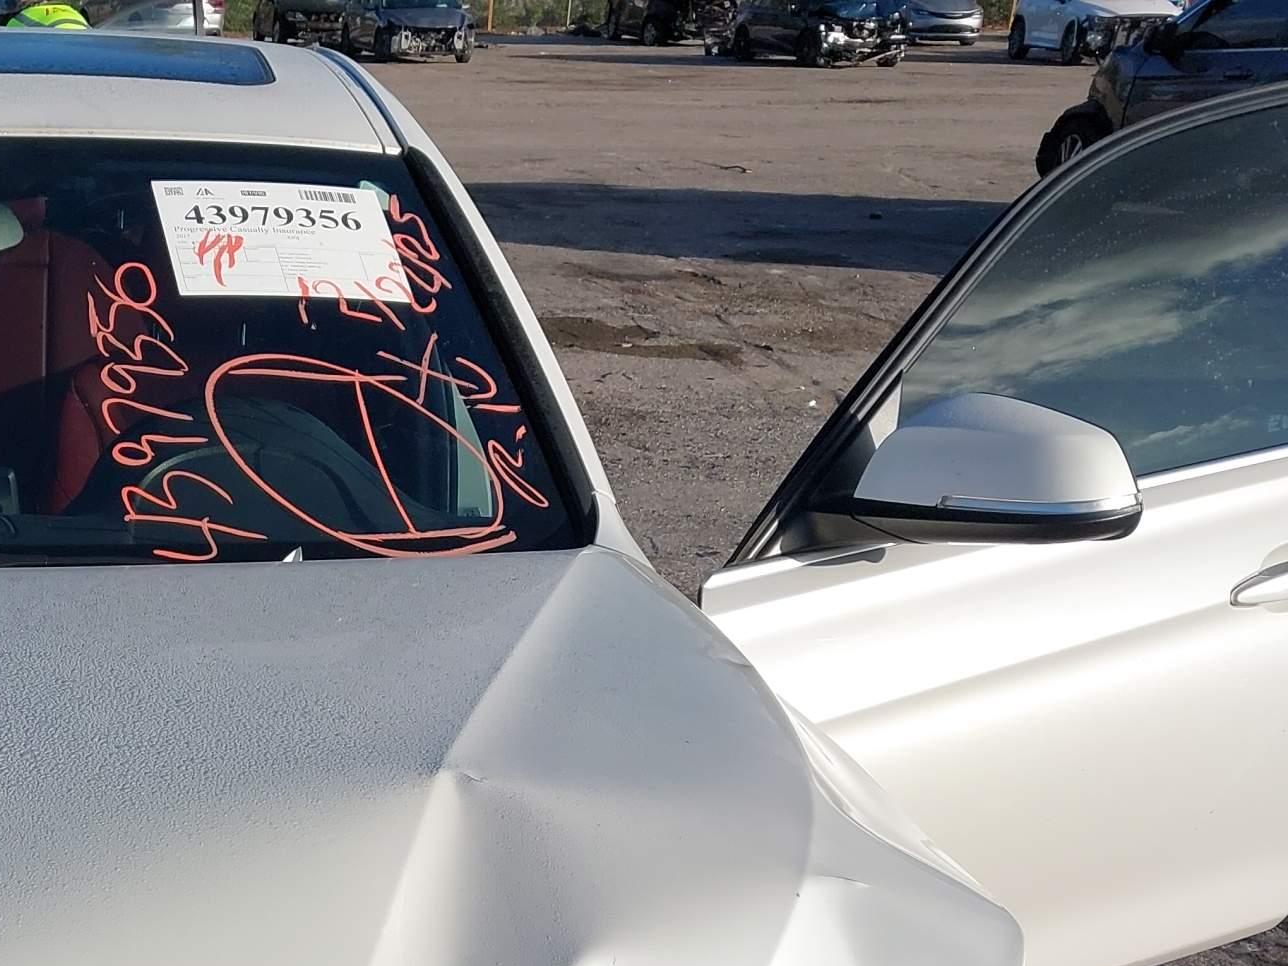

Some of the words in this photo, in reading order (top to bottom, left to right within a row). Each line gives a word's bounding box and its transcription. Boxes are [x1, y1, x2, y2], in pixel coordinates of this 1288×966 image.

[173, 225, 228, 234] Progressive
[229, 226, 270, 235] Casualty
[272, 227, 317, 235] Insurance
[184, 204, 363, 231] 43979356
[87, 261, 270, 562] 43979356
